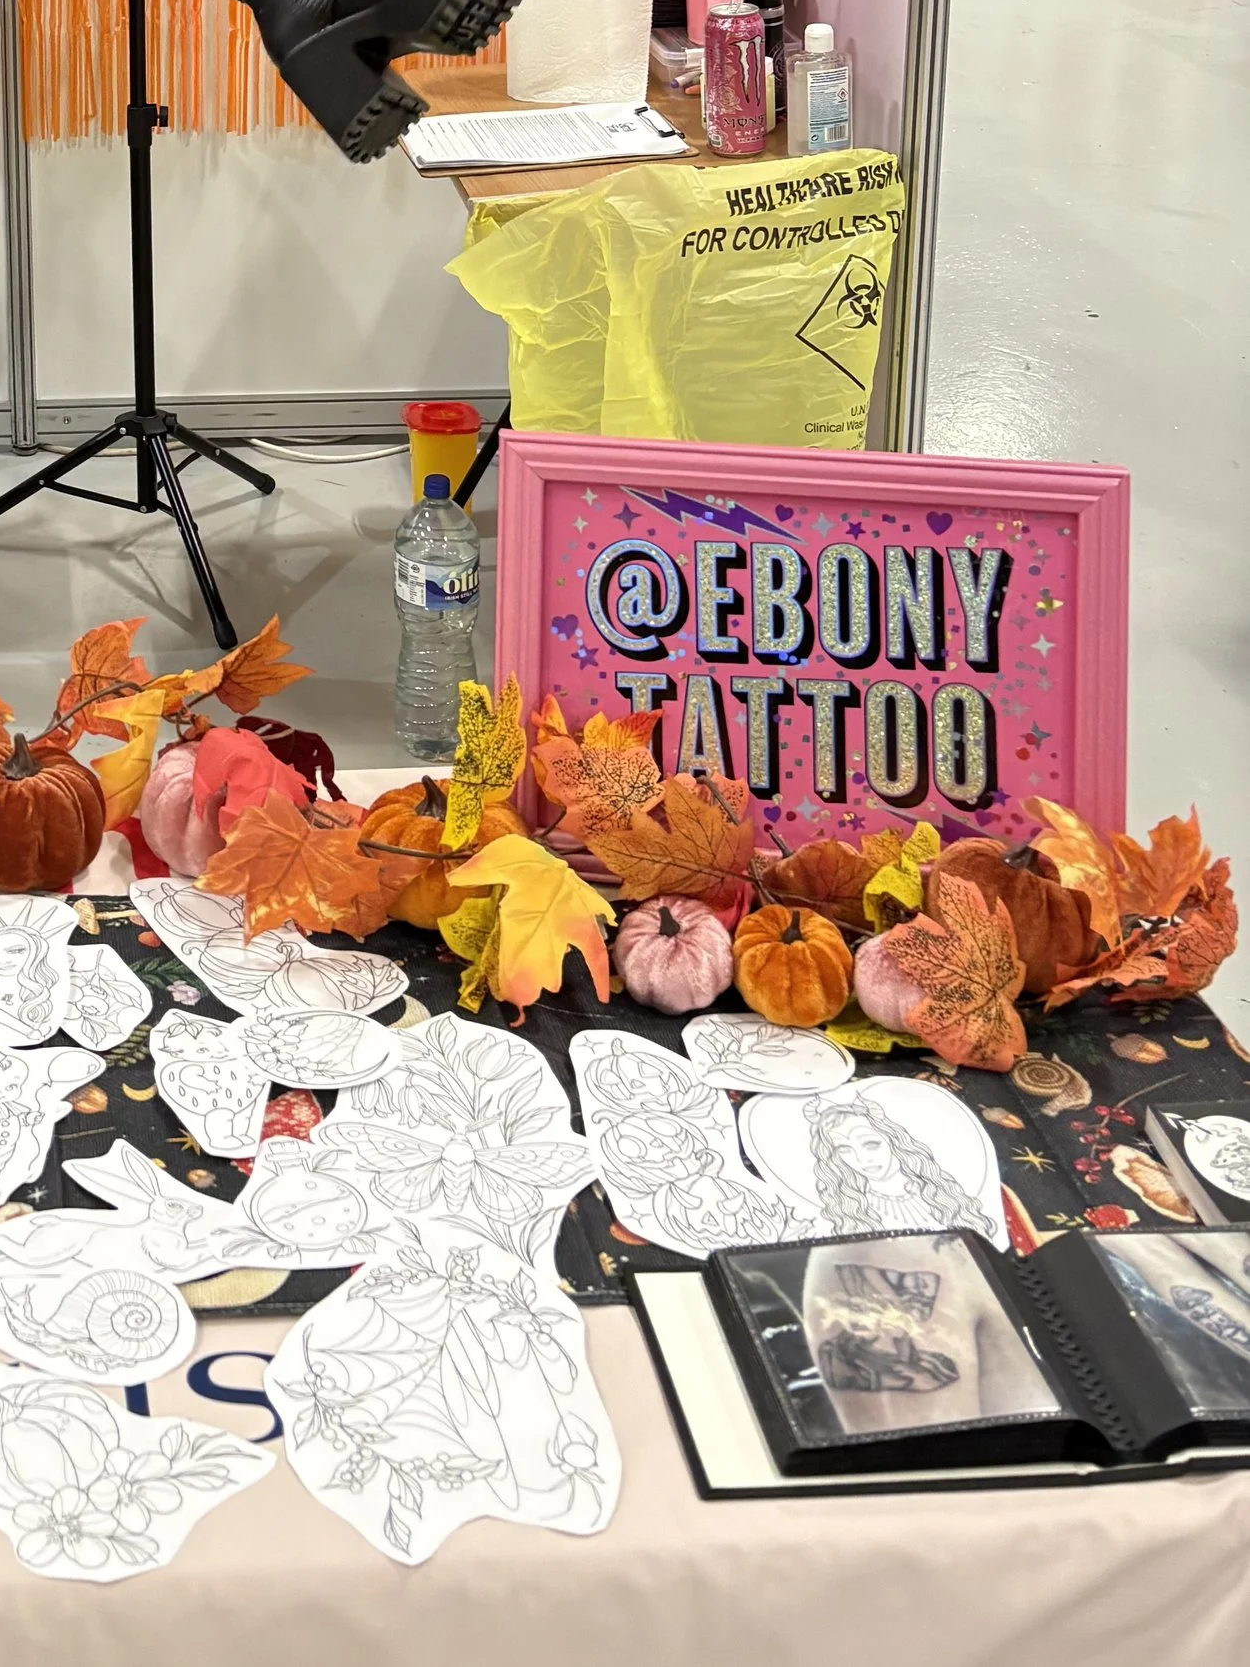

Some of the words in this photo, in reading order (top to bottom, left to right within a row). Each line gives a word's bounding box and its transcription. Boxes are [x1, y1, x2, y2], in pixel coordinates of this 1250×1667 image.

[681, 226, 727, 258] FOR
[732, 214, 886, 251] CONTROLLED
[804, 422, 844, 433] Clinical
[586, 539, 1010, 672] @EBONY
